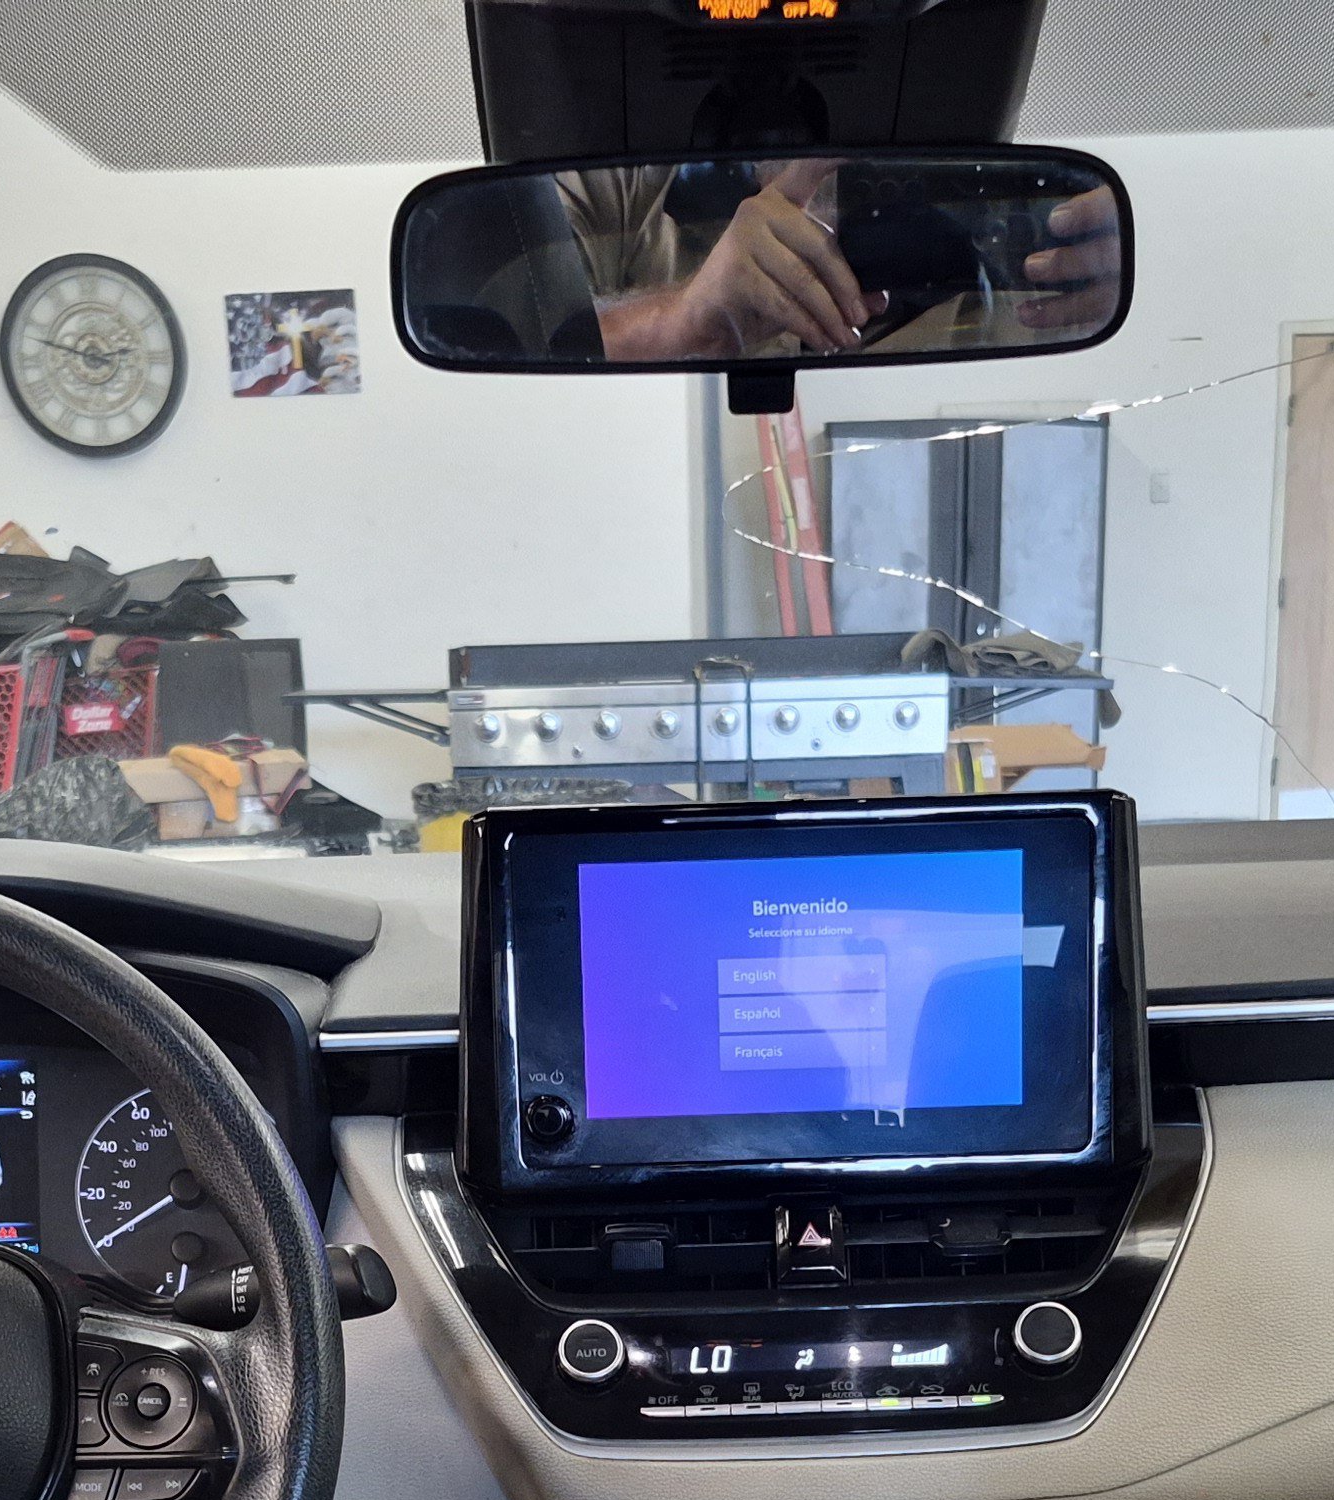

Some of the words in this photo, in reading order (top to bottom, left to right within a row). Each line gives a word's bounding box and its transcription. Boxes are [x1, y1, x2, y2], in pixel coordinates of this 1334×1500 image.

[752, 898, 849, 917] Bienvenido
[733, 970, 776, 984] English
[734, 1007, 781, 1022] Español
[735, 1046, 783, 1060] Français
[528, 1073, 548, 1082] VOL
[131, 1107, 150, 1120] 60
[149, 1128, 168, 1138] 100
[99, 1140, 117, 1153] 40
[135, 1142, 149, 1152] 80
[122, 1158, 137, 1168] 60
[116, 1180, 131, 1190] 40
[87, 1187, 105, 1200] 20
[117, 1201, 132, 1211] 20
[166, 1272, 174, 1283] E
[236, 1275, 249, 1284] OFF
[575, 1348, 607, 1358] AUTO
[689, 1345, 733, 1374] LO
[831, 1381, 854, 1391] ECO
[968, 1384, 991, 1393] A/C
[138, 1397, 163, 1406] CANCEL
[658, 1395, 679, 1405] OFF
[75, 1483, 102, 1492] MODE
